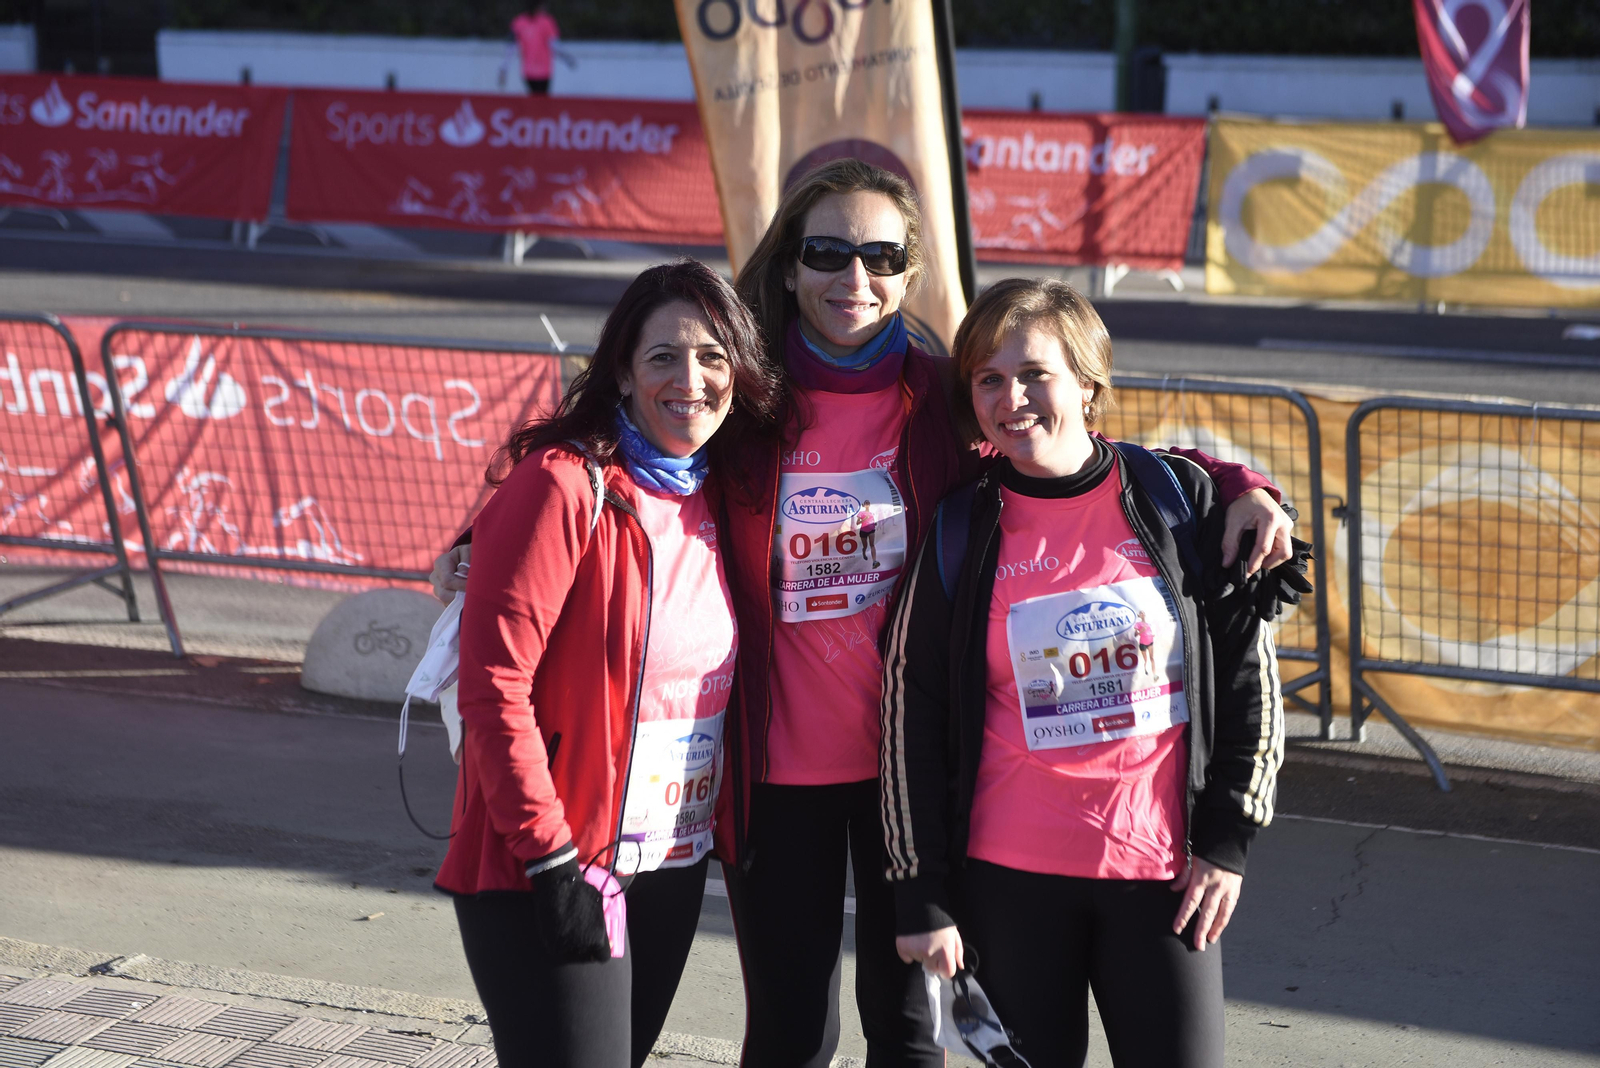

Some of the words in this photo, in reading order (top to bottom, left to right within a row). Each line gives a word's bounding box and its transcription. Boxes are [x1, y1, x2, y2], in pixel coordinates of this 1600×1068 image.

[75, 90, 249, 138] Santander
[325, 100, 436, 150] Sports
[487, 107, 679, 155] Santander
[787, 500, 856, 515] ASTURIANA
[789, 530, 858, 560] 016
[807, 562, 841, 577] 1582
[995, 556, 1060, 581] OYSHO
[779, 579, 815, 591] CARRERA
[817, 577, 830, 588] DE
[832, 576, 845, 586] LA
[847, 573, 880, 585] MUJER
[818, 599, 843, 607] Santander
[1063, 615, 1132, 636] ASTURIANA
[1069, 643, 1139, 679] 016
[1089, 679, 1124, 697] 1581
[1056, 700, 1100, 715] CARRERA
[1102, 697, 1116, 707] DE
[1117, 695, 1131, 704] LA
[1130, 686, 1161, 702] MUJER
[1033, 722, 1086, 740] OYSHO
[664, 775, 710, 806] 016
[674, 810, 696, 826] 1580
